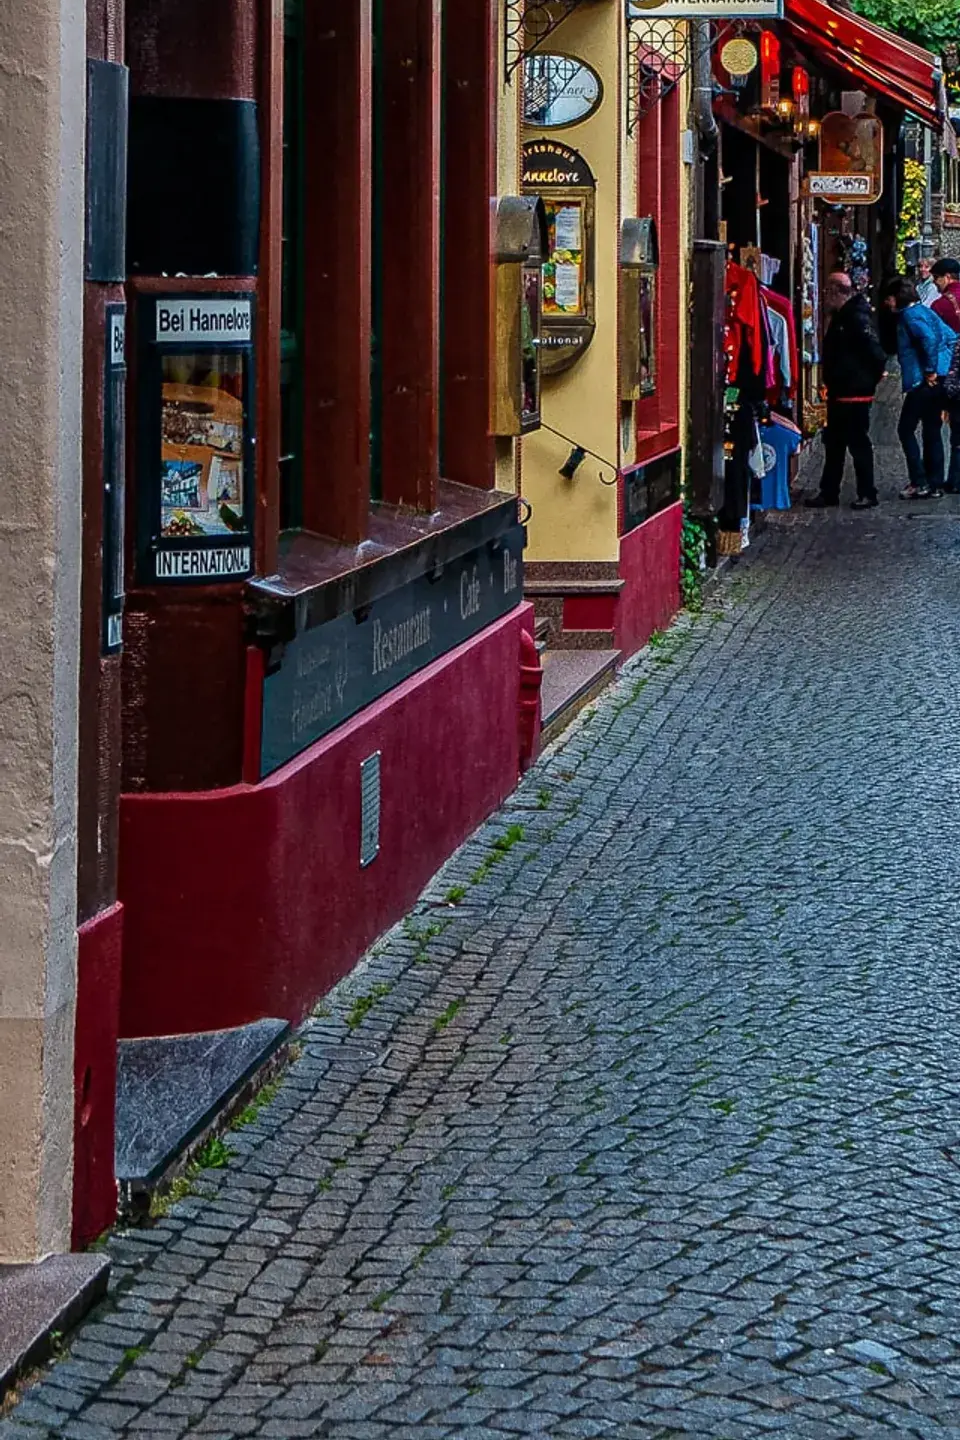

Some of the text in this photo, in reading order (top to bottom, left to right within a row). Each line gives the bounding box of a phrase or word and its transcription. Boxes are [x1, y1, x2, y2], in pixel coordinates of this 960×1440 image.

[523, 144, 576, 163] irtshaus
[522, 167, 580, 184] annelore
[158, 306, 251, 332] Bei Hannelore
[157, 550, 250, 575] INTERNATIONAL
[372, 608, 431, 674] Restaurant
